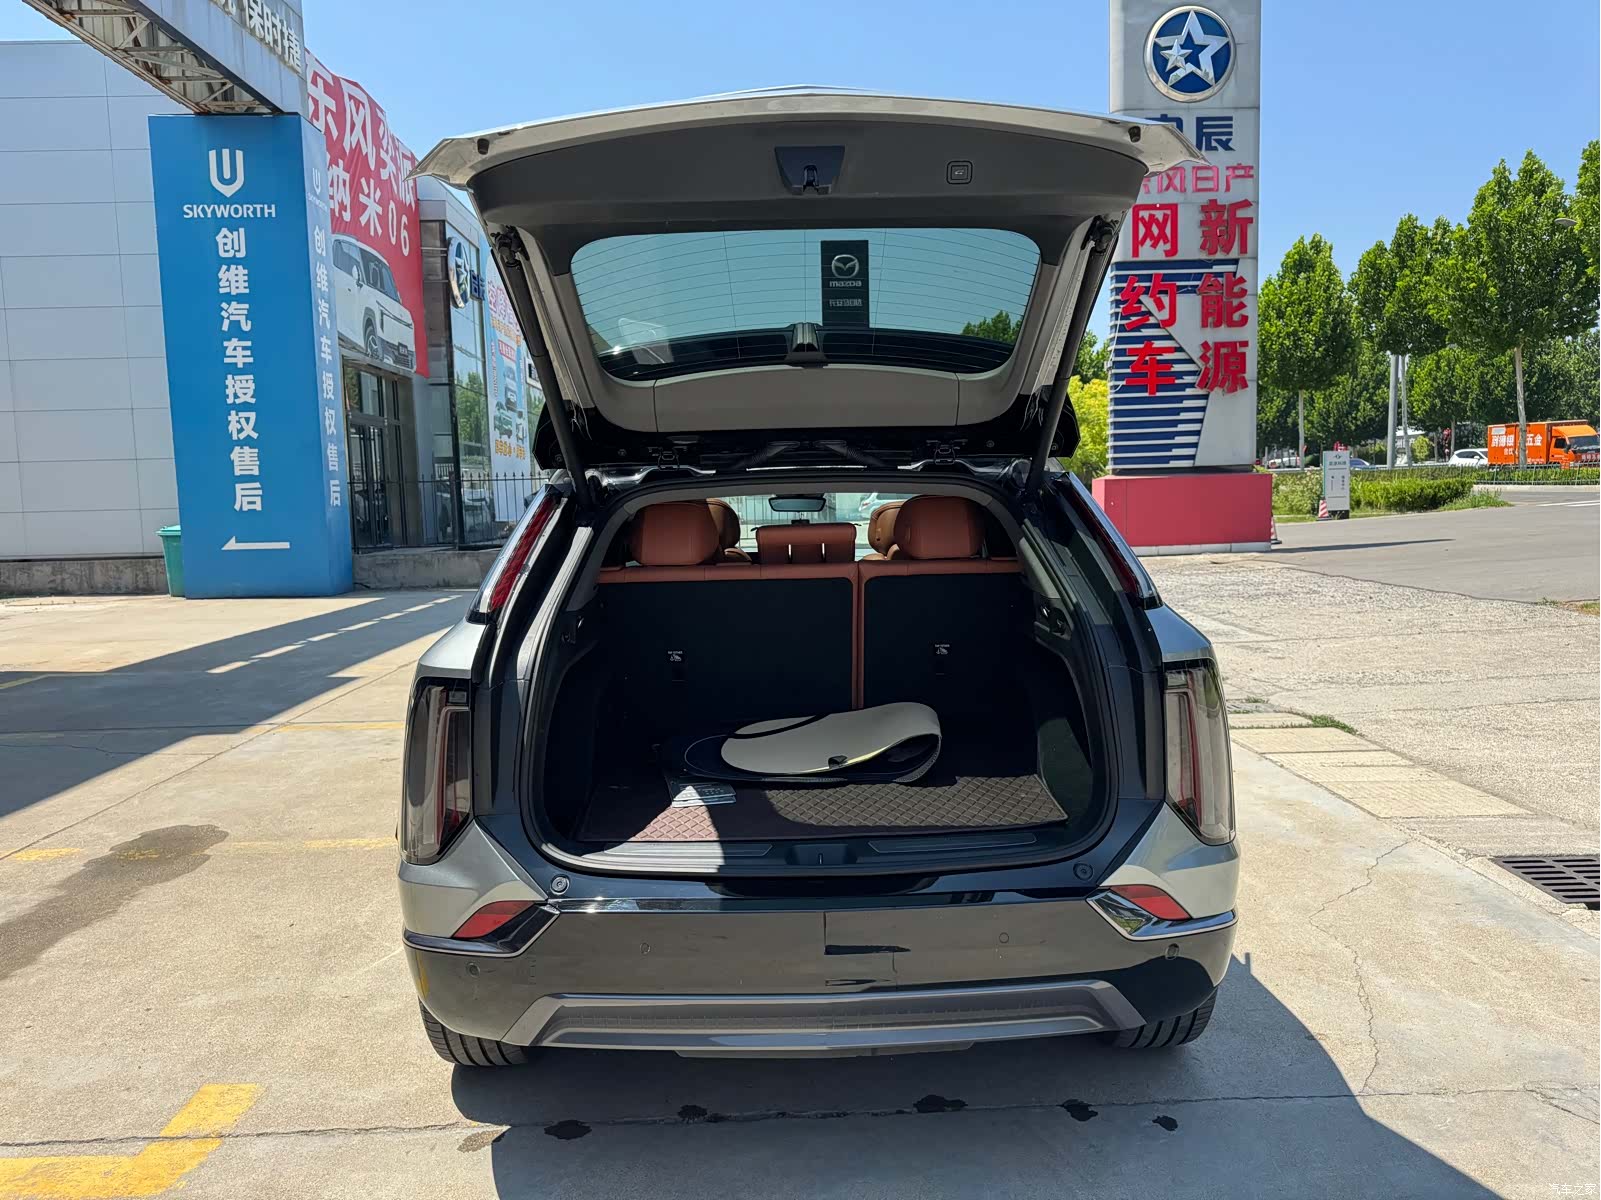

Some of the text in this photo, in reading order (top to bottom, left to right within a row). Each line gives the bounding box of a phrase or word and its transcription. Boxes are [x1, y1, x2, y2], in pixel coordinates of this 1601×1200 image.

[183, 203, 276, 219] SKYWORTH
[1145, 114, 1236, 151] 辰
[215, 227, 263, 512] 创维汽车授权售后
[313, 225, 341, 507] 创维汽车授权售后
[1119, 202, 1179, 396] 网约车
[1194, 198, 1254, 395] 新能源
